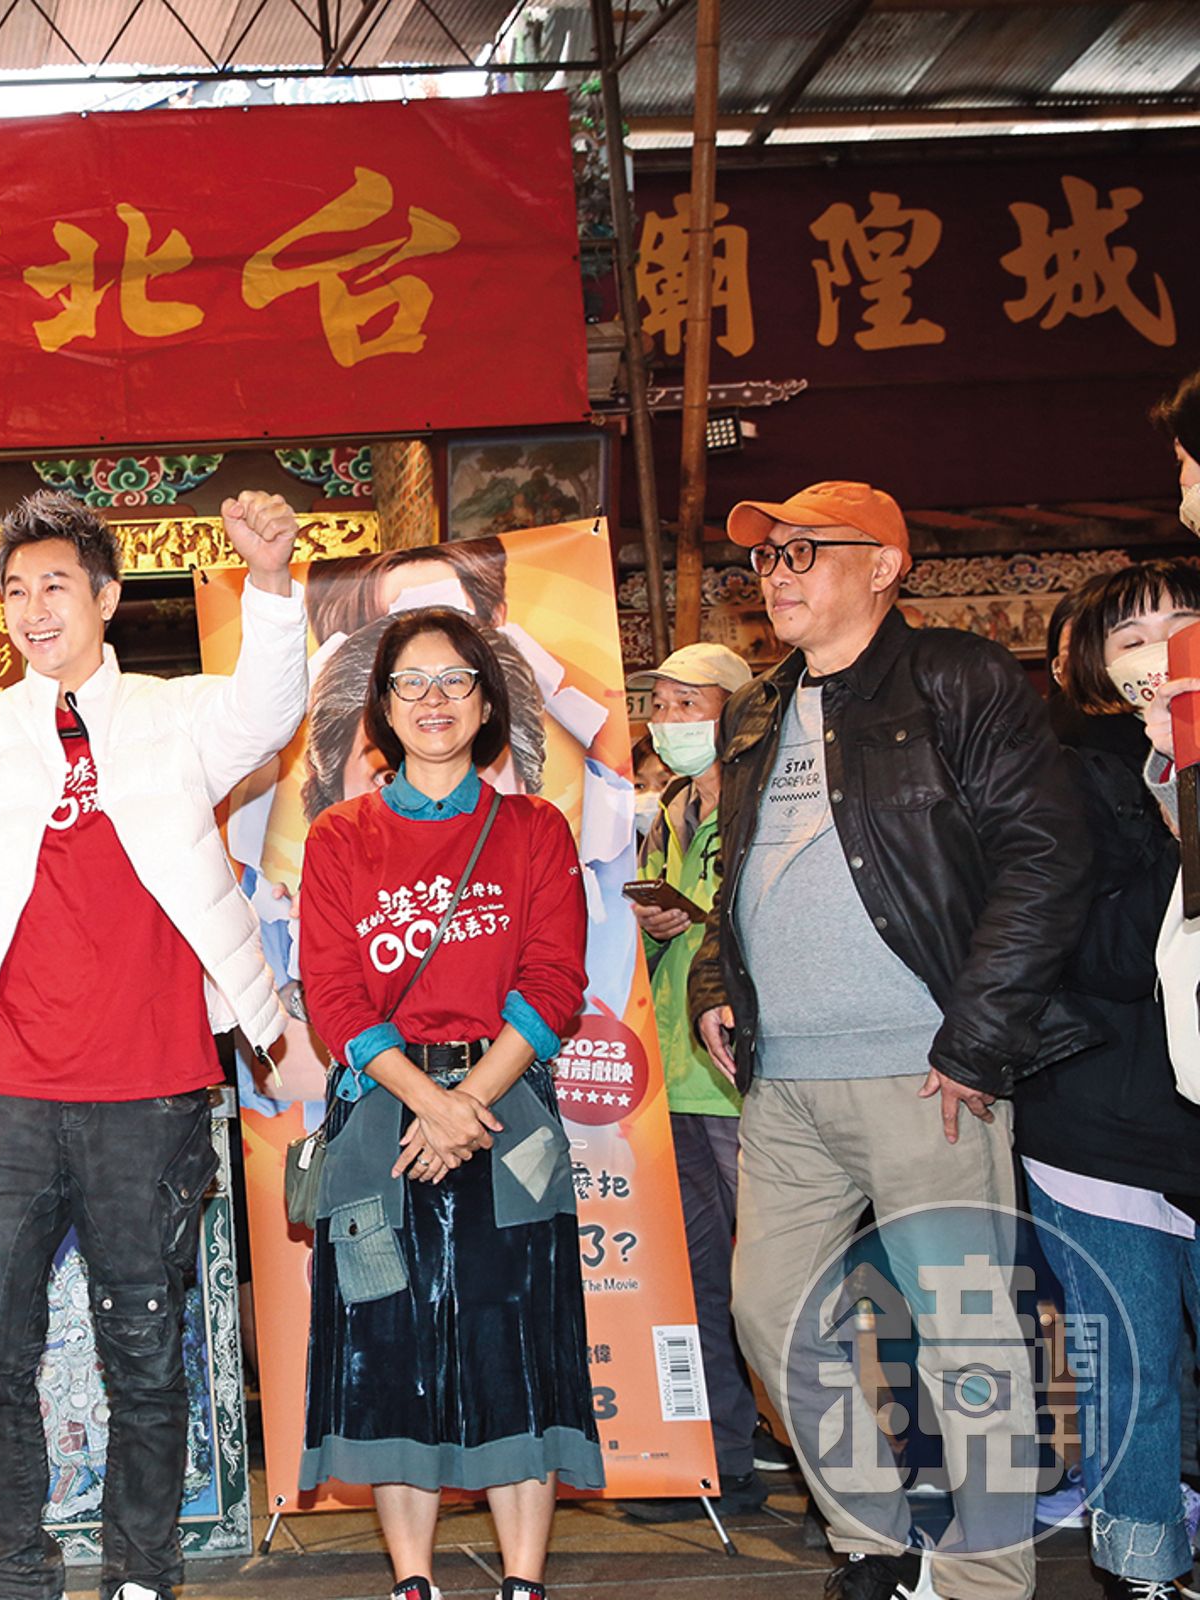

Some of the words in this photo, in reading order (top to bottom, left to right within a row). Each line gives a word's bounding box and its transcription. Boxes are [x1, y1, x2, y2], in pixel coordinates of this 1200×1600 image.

[785, 758, 815, 774] STAY
[561, 1038, 626, 1059] 2023
[603, 1277, 638, 1291] Movie
